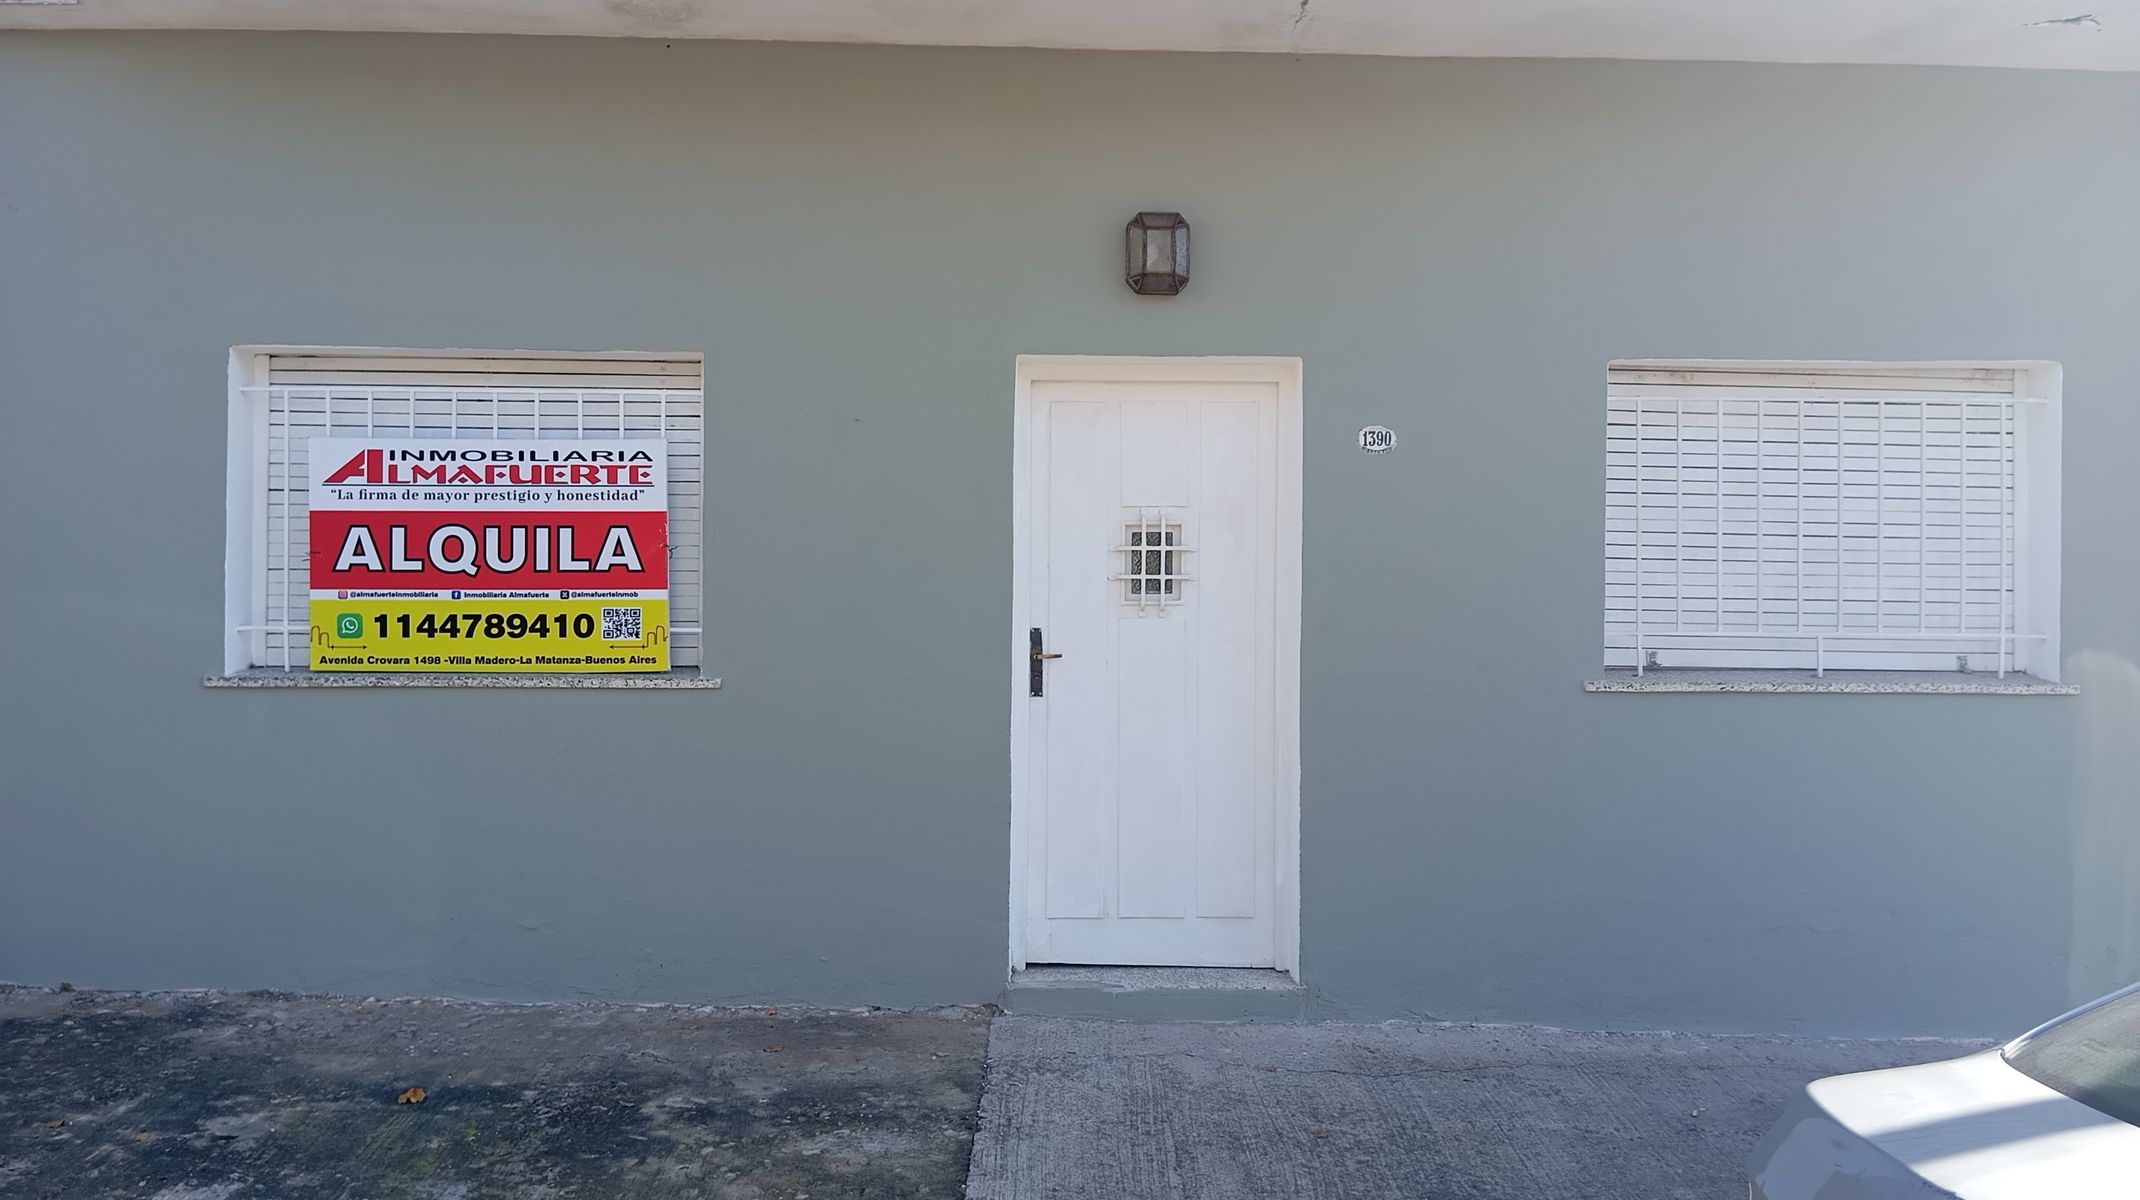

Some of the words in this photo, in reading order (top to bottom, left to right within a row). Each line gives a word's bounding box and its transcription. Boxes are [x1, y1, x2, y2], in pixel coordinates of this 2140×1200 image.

[1363, 430, 1391, 447] 1390
[389, 450, 653, 462] INMOBILIARIA
[323, 449, 653, 485] ALMAFUERTE
[359, 489, 397, 500] firma
[402, 490, 419, 500] de
[424, 491, 470, 503] mayor
[474, 490, 540, 503] prestigio
[544, 492, 552, 503] y
[332, 524, 645, 578] ALQUILA
[374, 613, 595, 639] 1144789410
[319, 656, 364, 665] Avenida
[367, 656, 410, 665] Crovara
[415, 656, 441, 665] 1498
[535, 656, 626, 665] Matanza-Buenos
[629, 656, 657, 665] Aires
